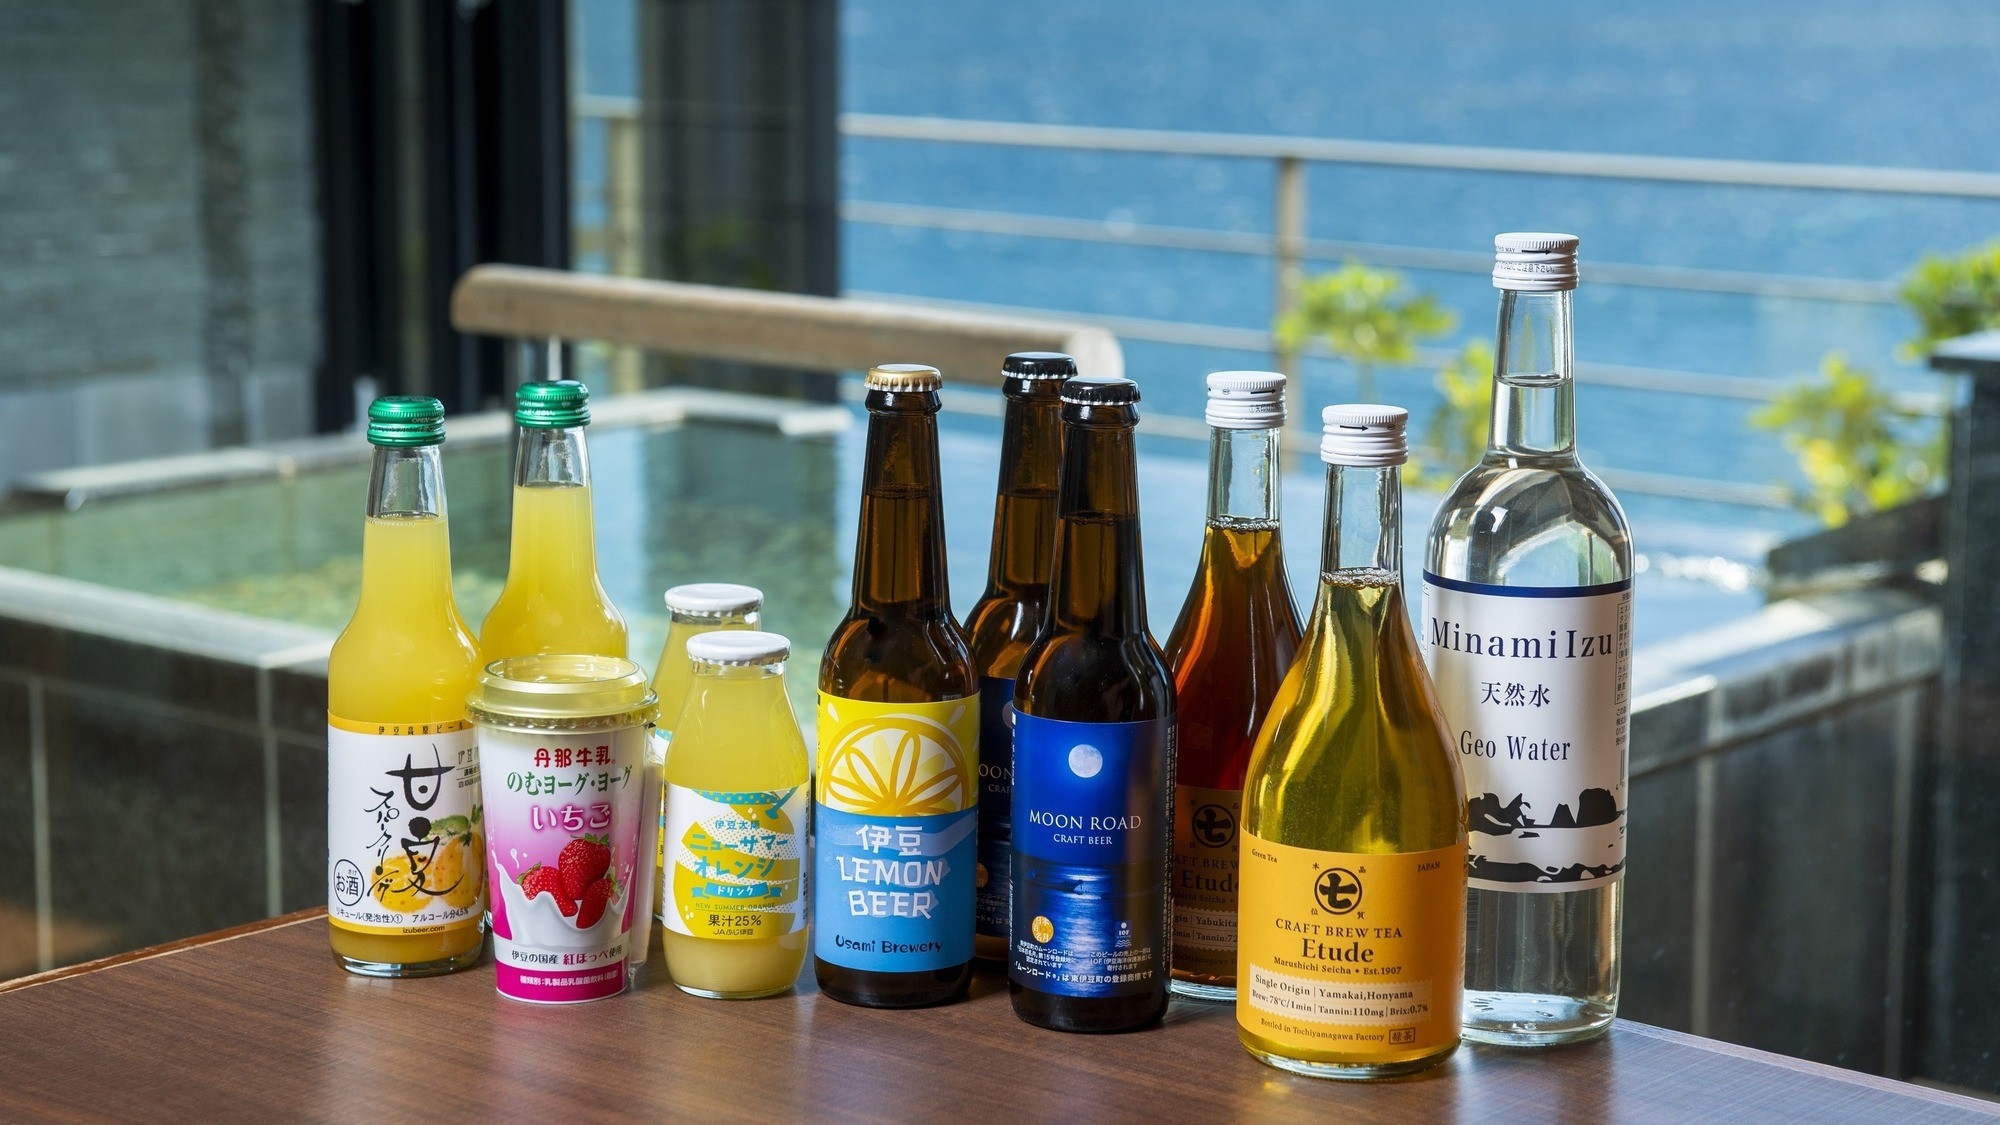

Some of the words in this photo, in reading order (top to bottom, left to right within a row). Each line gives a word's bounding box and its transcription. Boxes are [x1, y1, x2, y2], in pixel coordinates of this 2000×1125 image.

[1431, 617, 1614, 659] MinamiIzu
[1481, 681, 1551, 707] 天然水
[378, 723, 464, 736] 伊豆高原ビール
[1460, 730, 1496, 759] Geo
[1506, 734, 1570, 761] Water
[507, 764, 633, 796] のむヨーグ・ヨーグ
[978, 763, 1013, 780] OON
[988, 783, 1012, 794] CRAF
[385, 743, 464, 895] 甘夏
[531, 803, 612, 832] いちご
[715, 819, 761, 830] 伊豆太陽
[1029, 809, 1083, 830] MOON
[1091, 815, 1142, 831] ROAD
[689, 833, 788, 853] ニューサマー
[855, 824, 923, 857] 伊豆
[1053, 833, 1085, 846] CRAFT
[1088, 835, 1113, 846] BEER
[693, 853, 781, 879] オレンジ
[1252, 848, 1267, 860] Green
[1267, 853, 1278, 863] Tea
[1417, 861, 1441, 871] JAPAN
[836, 855, 945, 886] LEMON
[336, 872, 359, 897] お酒
[717, 885, 754, 896] ドリンク
[1318, 872, 1358, 909] 七
[714, 903, 744, 911] SUMMER
[848, 889, 932, 920] BEER
[402, 924, 446, 934] izubeer.com
[708, 914, 762, 927] 果汁25%
[1275, 918, 1321, 935] CRAFT
[1325, 926, 1368, 938] BREW
[1374, 927, 1403, 938] TEA
[512, 949, 559, 965] 伊豆の国産
[563, 944, 623, 966] 紅ほっぺ使用
[835, 934, 876, 953] Usami
[881, 939, 944, 954] Brewery
[1301, 938, 1374, 963] Etude
[1273, 956, 1319, 972] Marushichi
[1321, 963, 1352, 975] Seicha
[1363, 966, 1402, 975] Est.1907
[1255, 974, 1278, 989] Single
[1280, 982, 1310, 996] Origin
[1318, 1004, 1385, 1019] Tannin:110mg
[1389, 1003, 1429, 1016] Brix:0.7%
[1260, 1017, 1282, 1031] Bottled
[1284, 1025, 1291, 1033] in
[1293, 1026, 1354, 1041] Tochiyamagawa
[1355, 1033, 1385, 1042] Factory
